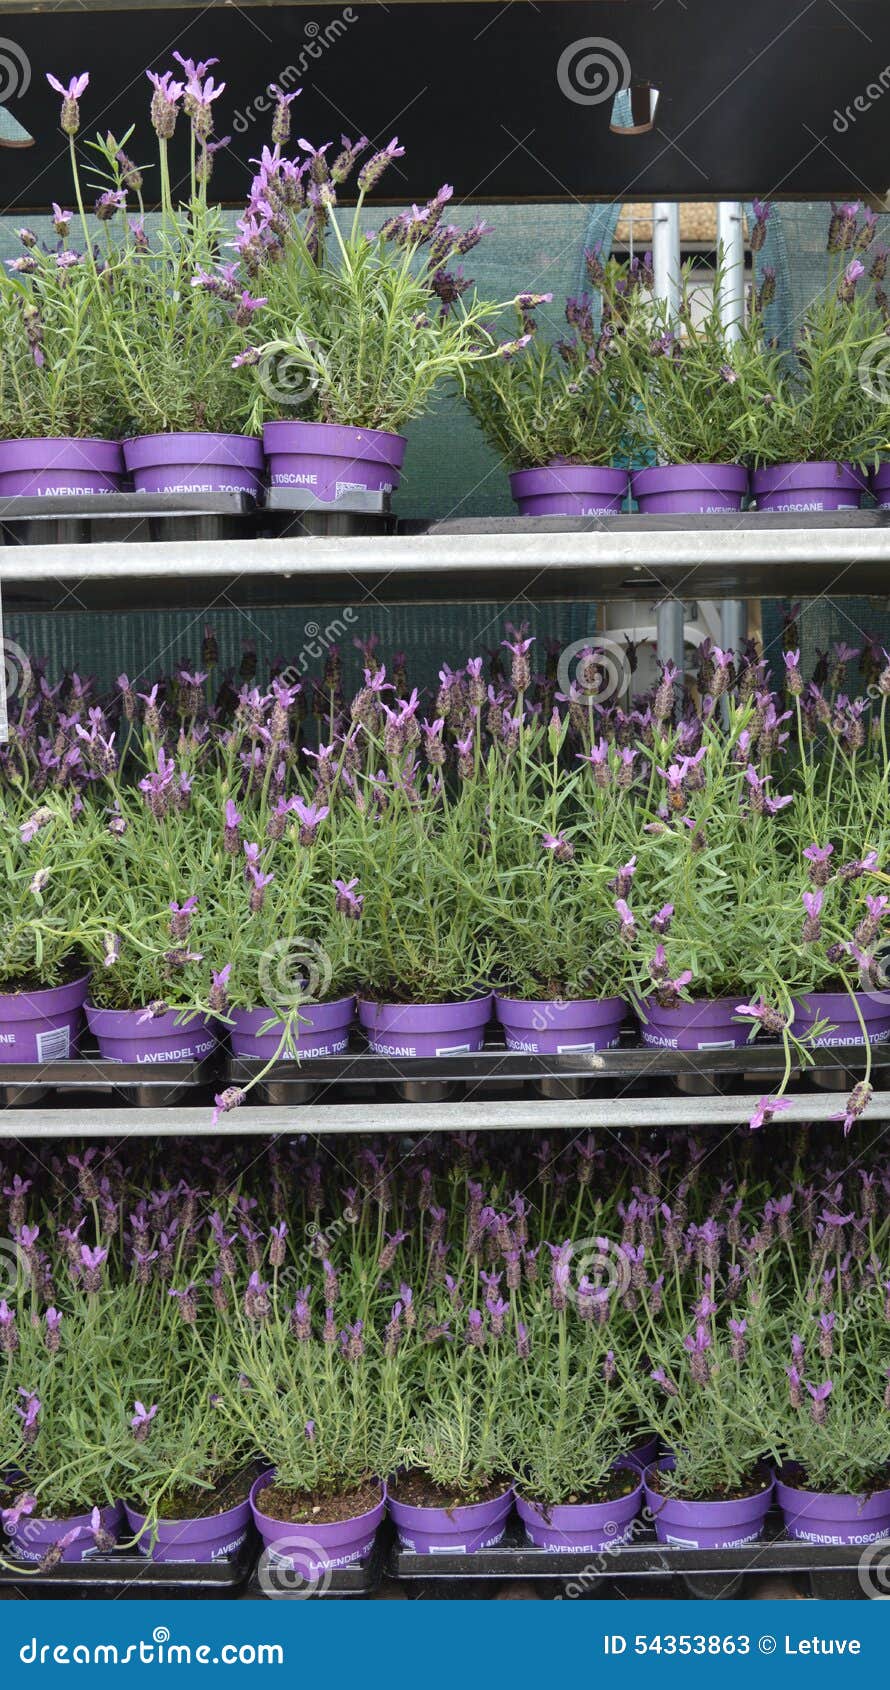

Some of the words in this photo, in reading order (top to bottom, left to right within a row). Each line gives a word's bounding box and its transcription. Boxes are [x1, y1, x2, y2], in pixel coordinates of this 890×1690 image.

[275, 473, 318, 484] TOSCANE
[777, 502, 824, 513] TOSCANE
[136, 1047, 195, 1063] LAVENDEL
[795, 1528, 846, 1545] LAVENDEL
[847, 1527, 890, 1545] TOSCANE
[310, 1550, 361, 1570] LAVENDEL
